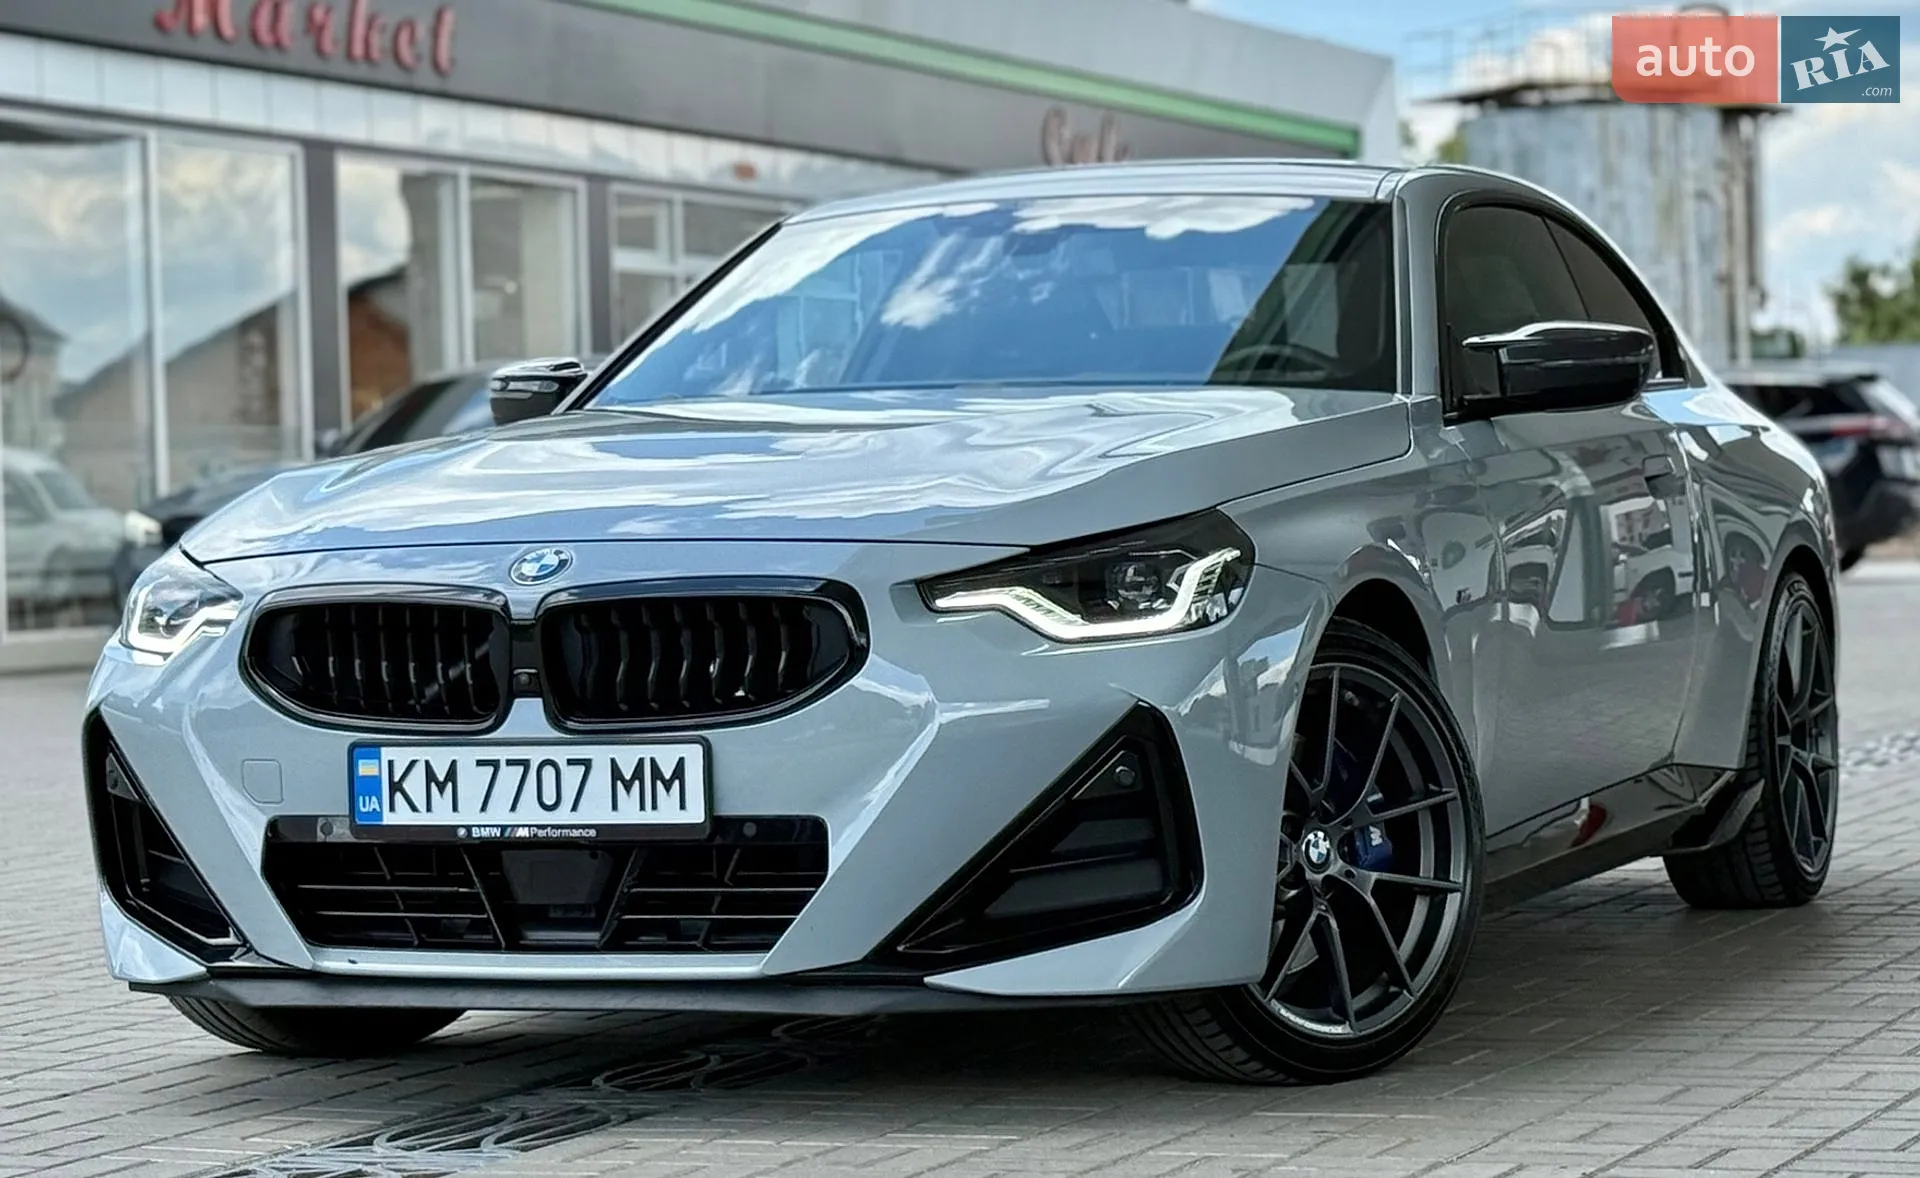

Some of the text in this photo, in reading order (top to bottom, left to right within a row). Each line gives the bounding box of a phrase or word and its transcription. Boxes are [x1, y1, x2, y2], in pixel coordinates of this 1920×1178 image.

[387, 756, 687, 813] KM 7707 MM
[358, 795, 381, 813] UA
[472, 826, 501, 838] BMW
